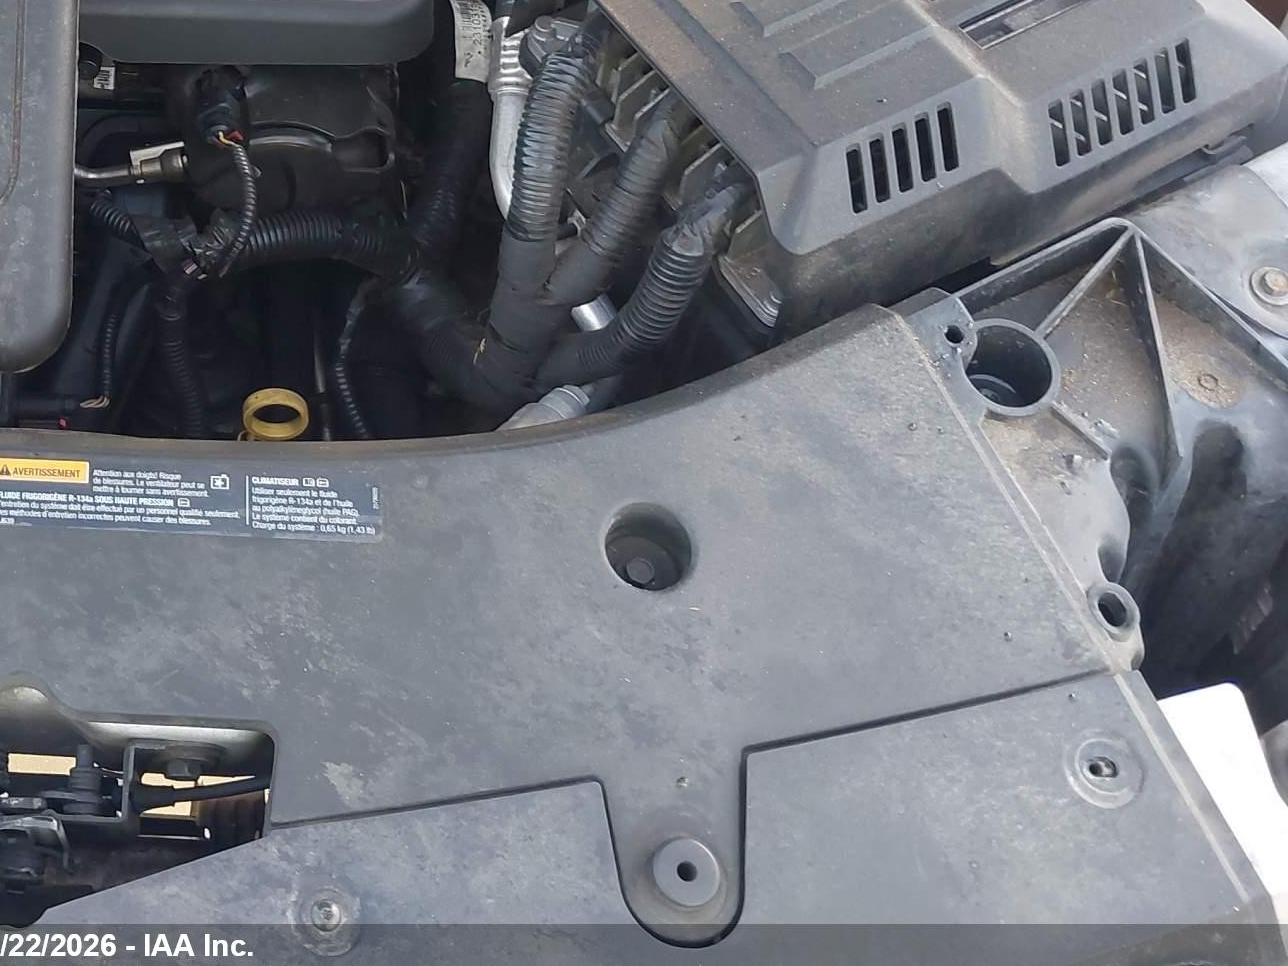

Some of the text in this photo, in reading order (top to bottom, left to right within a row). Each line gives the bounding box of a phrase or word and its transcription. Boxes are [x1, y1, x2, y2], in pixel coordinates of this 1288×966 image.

[12, 467, 81, 478] AVERTISSEMENT
[93, 469, 122, 478] Attention
[159, 471, 182, 481] Risque
[93, 477, 101, 485] de
[136, 479, 144, 487] Le
[144, 479, 180, 489] ventilateur
[180, 481, 196, 489] peut
[252, 476, 300, 486] CLIMATISEUR
[93, 485, 114, 493] mettre
[121, 486, 144, 495] tourner
[252, 487, 274, 495] Utiliser
[275, 488, 311, 498] seulement
[318, 490, 338, 499] fluide
[22, 490, 68, 502] FRIGORIGÈNE
[68, 493, 94, 502] R-134a
[94, 495, 114, 504] SOUS
[114, 496, 138, 505] HAUTE
[138, 497, 174, 507] PRESSION
[252, 495, 288, 505] frigorigène
[288, 497, 314, 506] R-134a
[322, 499, 332, 507] de
[30, 500, 39, 509] du
[40, 501, 68, 511] système
[68, 503, 81, 512] doit
[82, 504, 95, 512] être
[96, 504, 123, 513] effectué
[123, 506, 135, 514] par
[145, 507, 178, 516] personnel
[179, 508, 203, 518] qualifié
[322, 507, 342, 516] (huile
[9, 509, 41, 518] méthodes
[42, 510, 77, 519] d'entretien
[78, 512, 114, 522] incorrectes
[114, 514, 141, 523] peuvent
[142, 515, 164, 523] causer
[165, 515, 178, 524] des
[252, 512, 261, 520] Le
[262, 513, 290, 522] système
[290, 514, 318, 523] contient
[252, 521, 276, 530] Charge
[276, 522, 286, 530] du
[287, 522, 316, 532] système
[337, 525, 347, 535] kg
